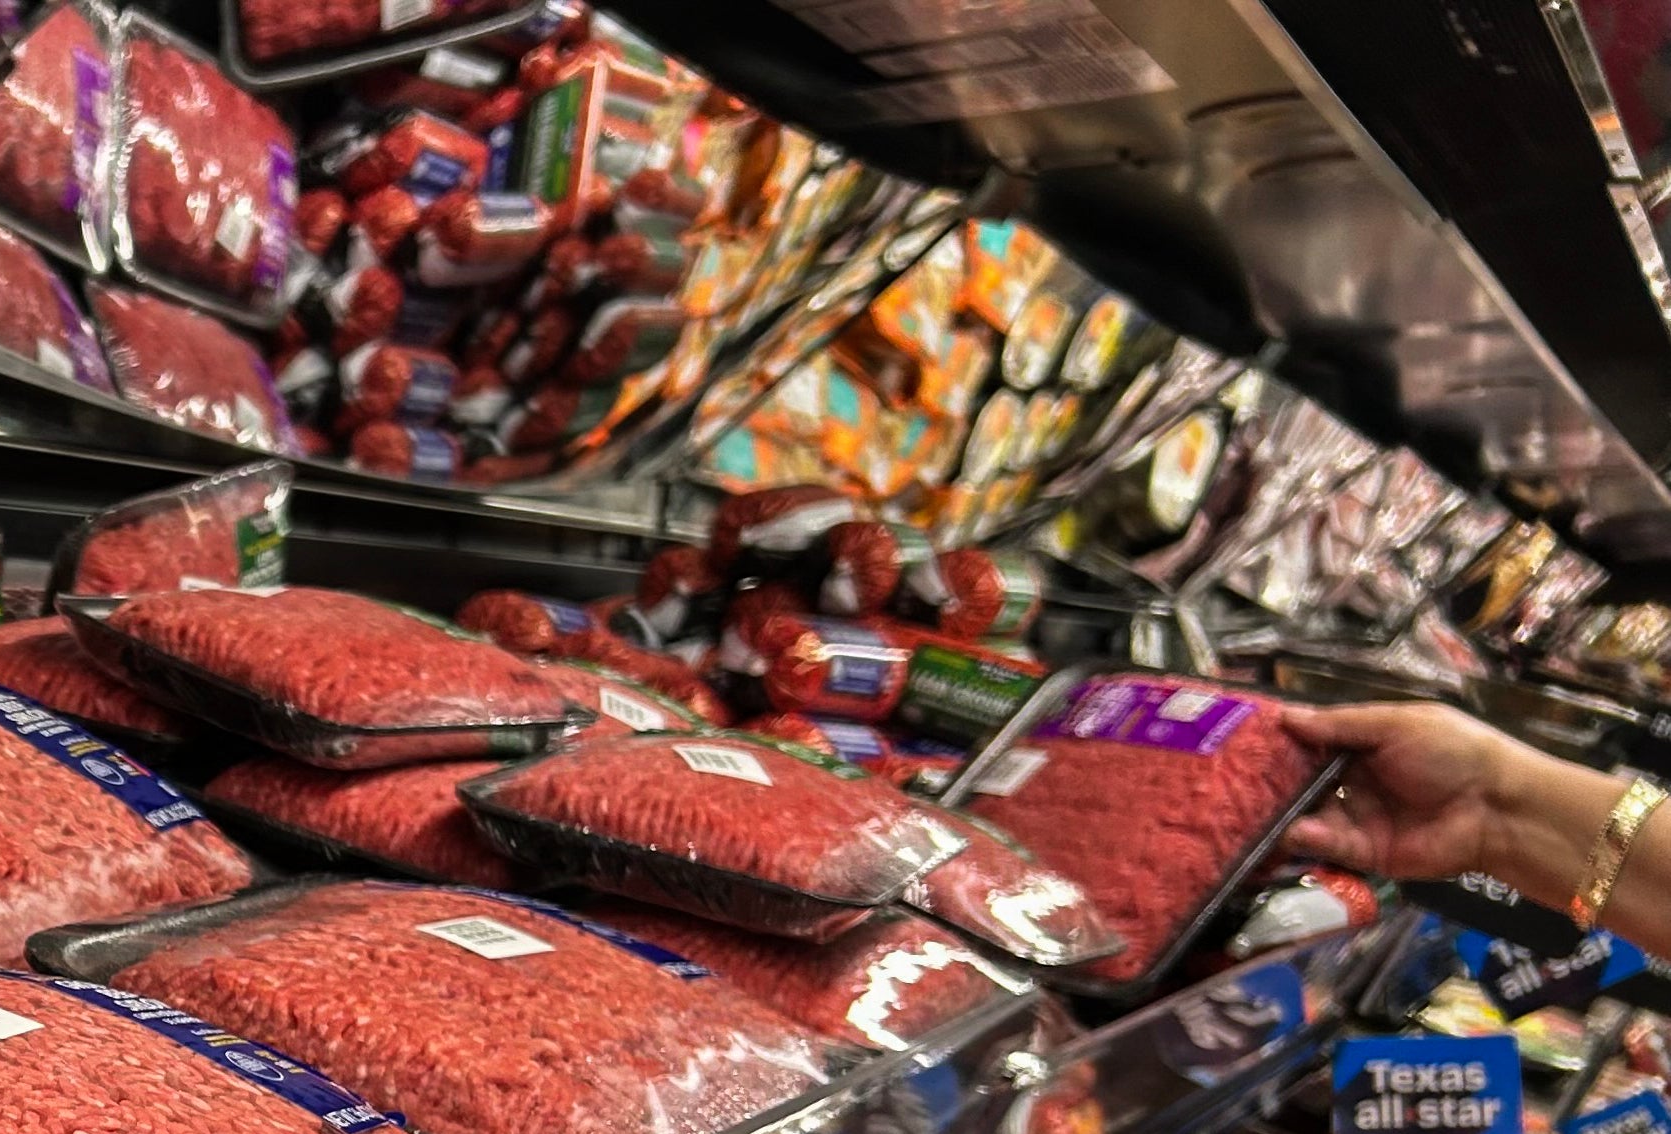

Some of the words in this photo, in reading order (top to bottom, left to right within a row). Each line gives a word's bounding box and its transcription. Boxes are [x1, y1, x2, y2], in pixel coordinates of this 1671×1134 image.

[1363, 1057, 1489, 1094] Texas
[1354, 1094, 1405, 1130] all
[1417, 1095, 1502, 1130] star
